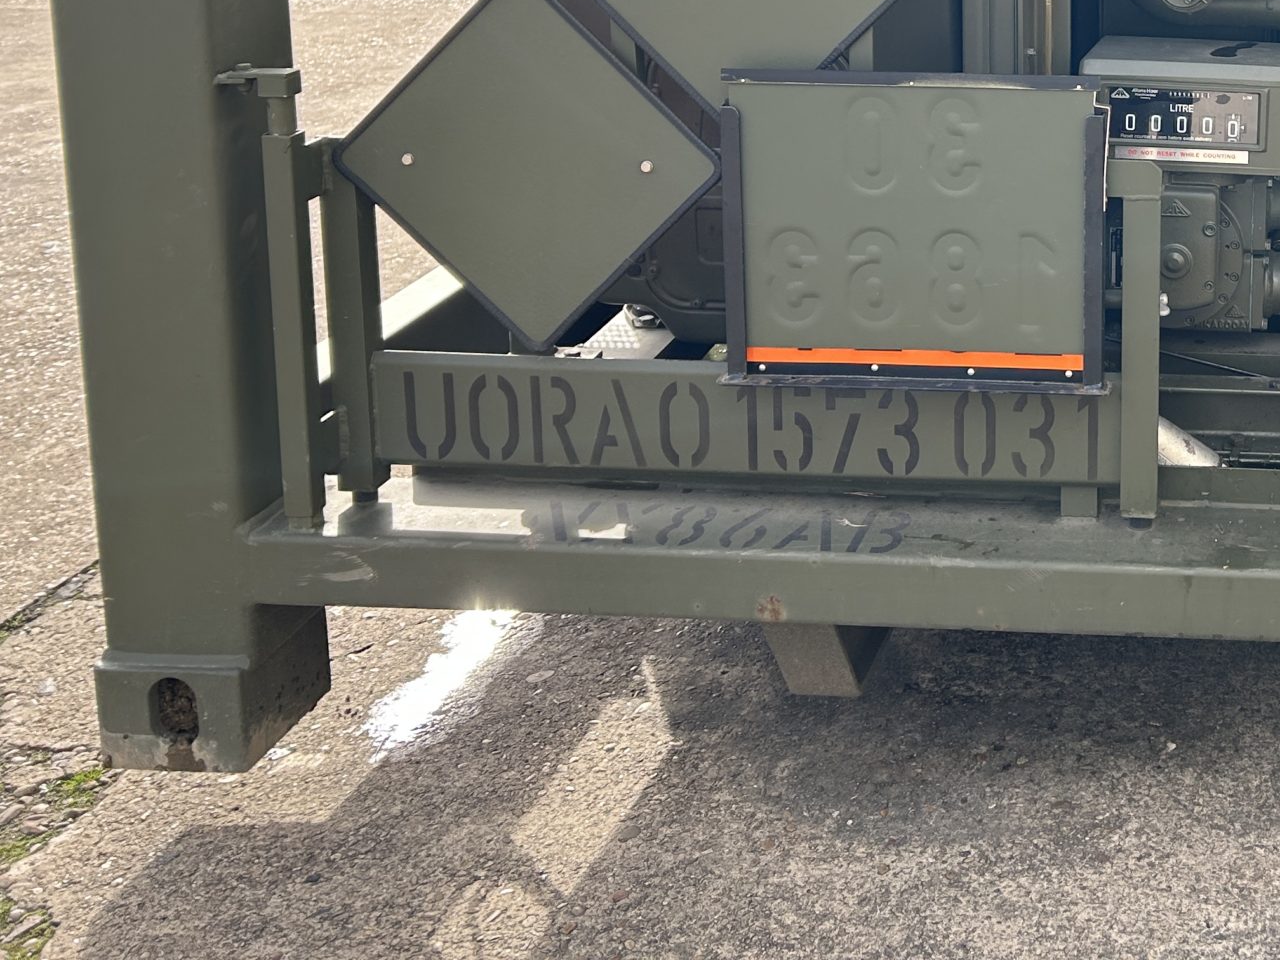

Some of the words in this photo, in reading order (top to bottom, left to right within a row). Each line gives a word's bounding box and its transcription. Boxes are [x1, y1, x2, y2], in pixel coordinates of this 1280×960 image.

[1170, 104, 1194, 113] LITRE
[1125, 114, 1136, 131] 0
[1151, 115, 1161, 132] 0
[1177, 116, 1187, 133] 0
[1202, 117, 1213, 134] 0
[1228, 121, 1238, 138] 0
[737, 385, 920, 476] 1573
[953, 391, 1099, 481] 031
